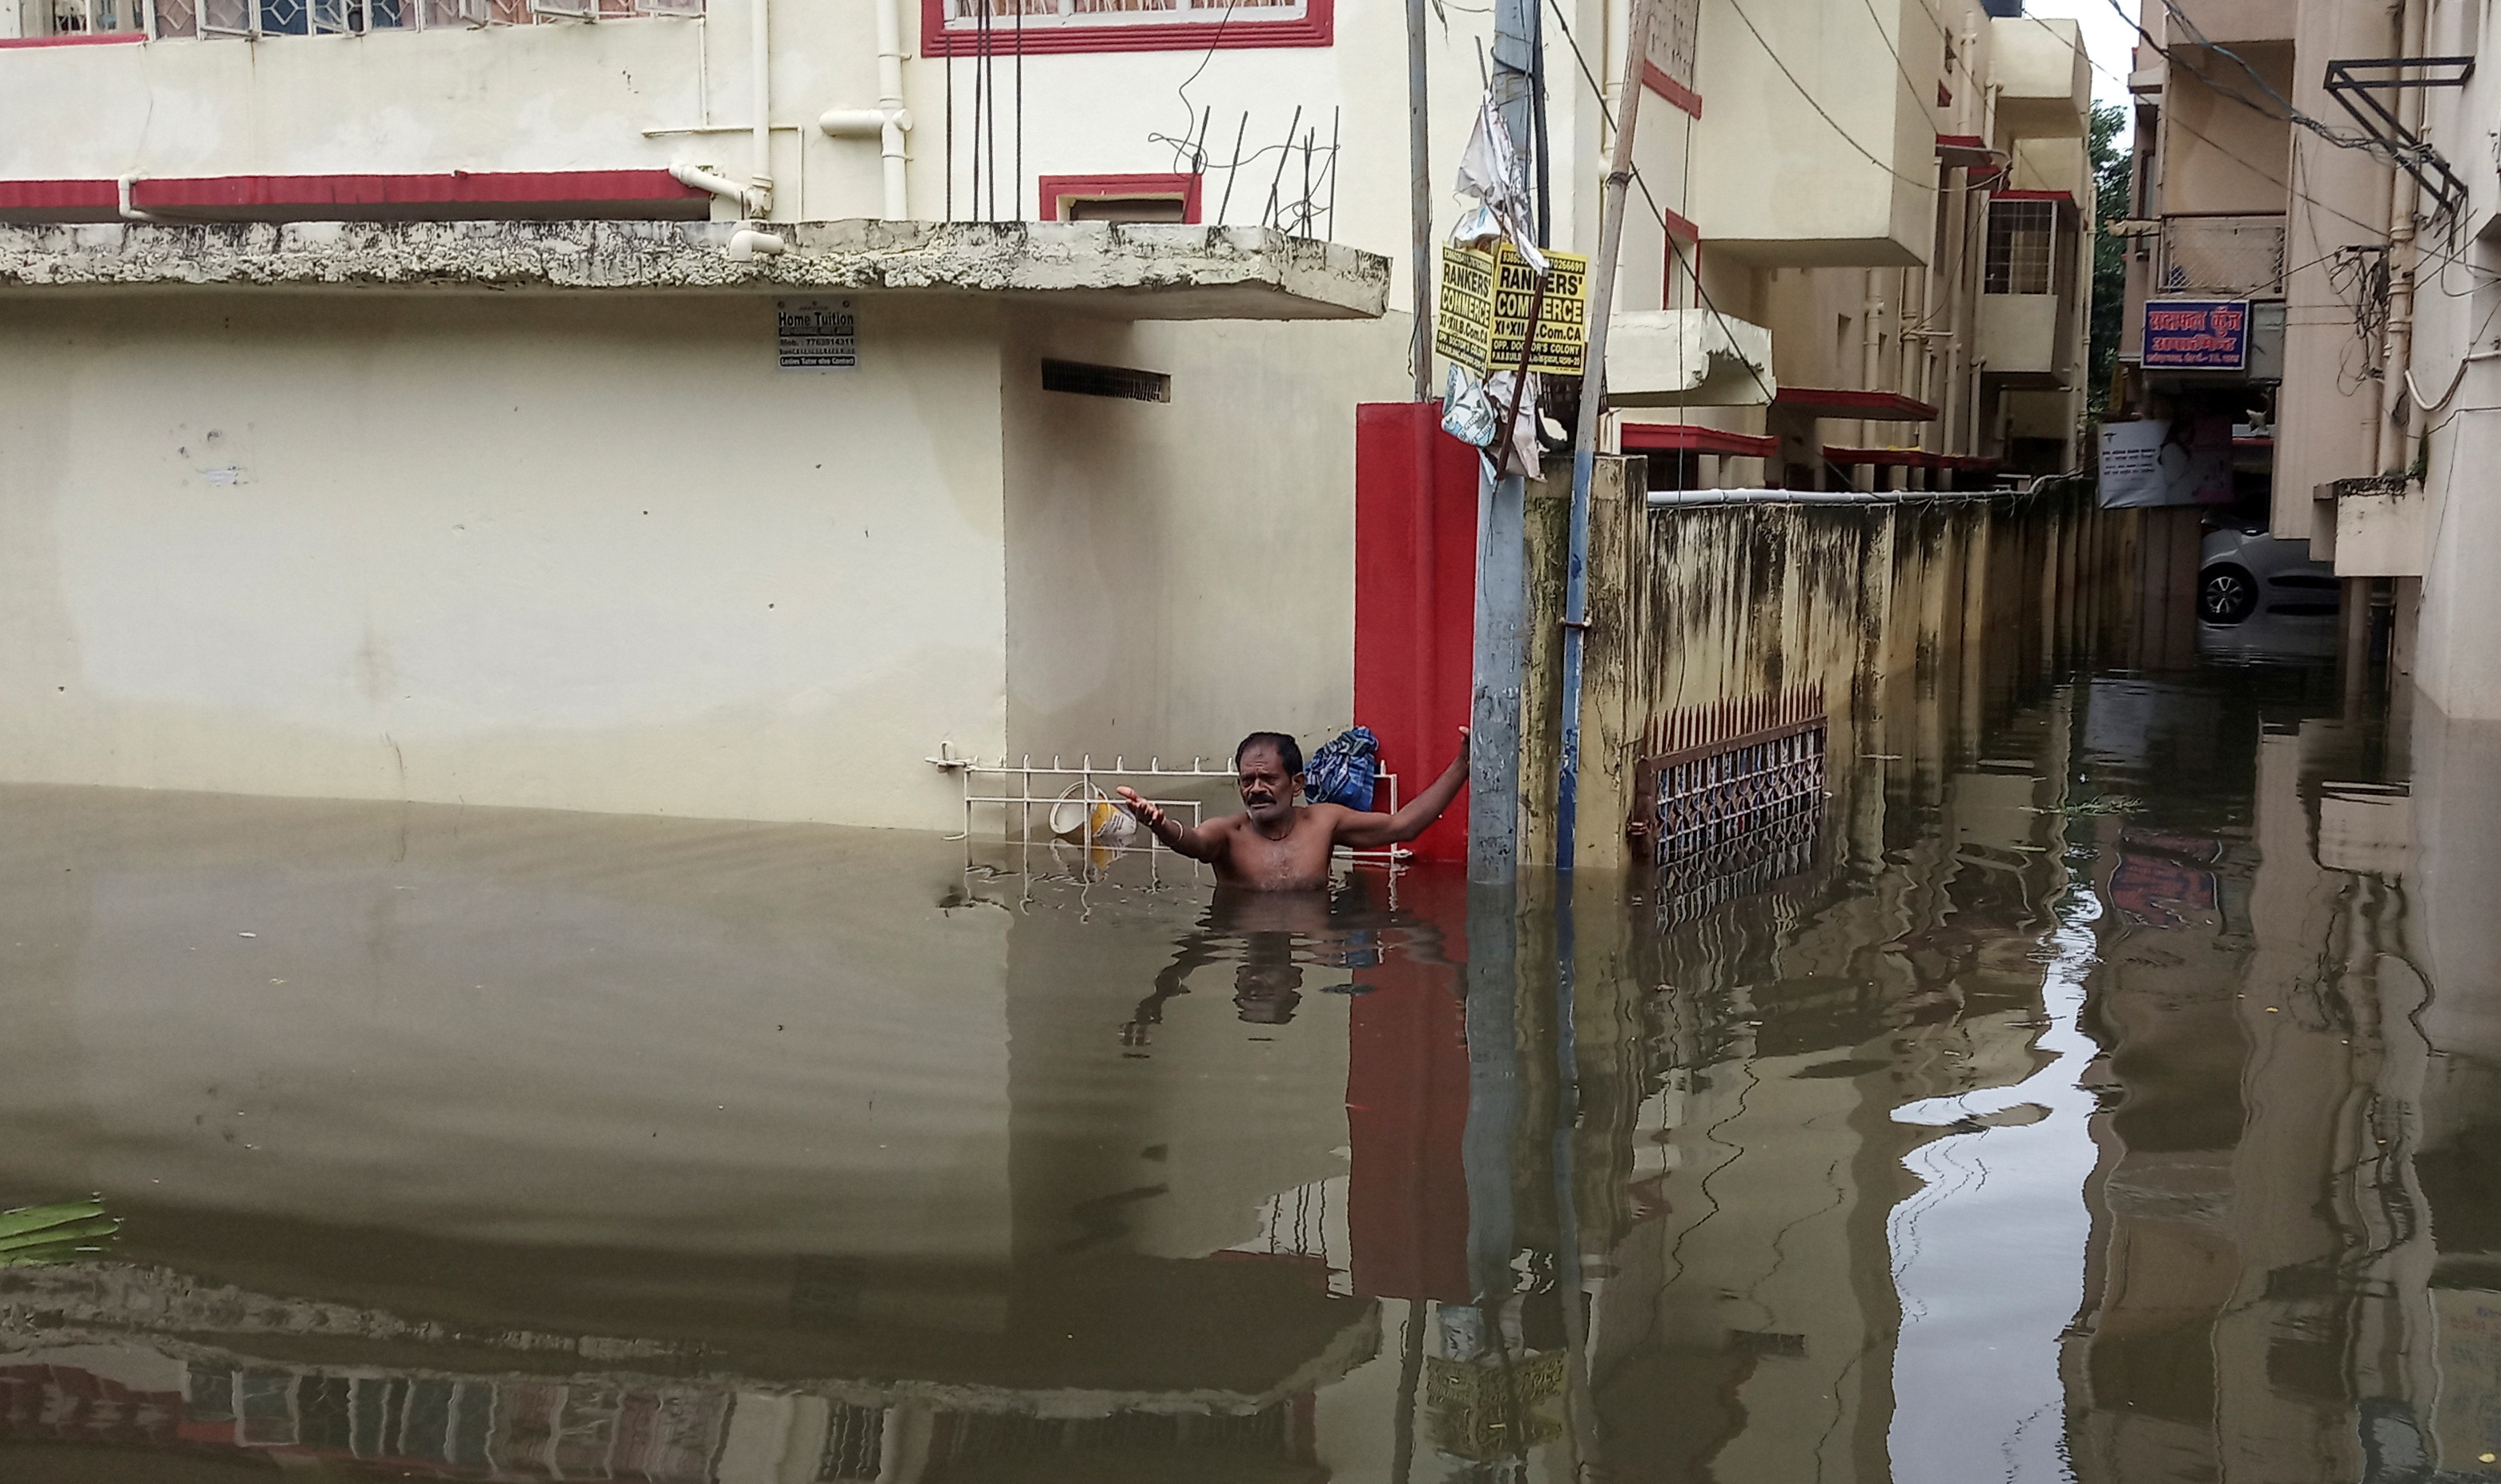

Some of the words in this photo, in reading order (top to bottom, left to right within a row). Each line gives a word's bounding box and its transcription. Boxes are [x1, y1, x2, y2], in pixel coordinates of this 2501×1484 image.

[1443, 263, 1491, 298] RANKERS'
[778, 312, 811, 326] Home
[814, 312, 854, 326] Tuition
[1441, 288, 1490, 326] COMMERCE
[1494, 340, 1509, 351] OPP.
[1511, 341, 1548, 353] DOCOR'S
[1550, 344, 1580, 356] COLONY
